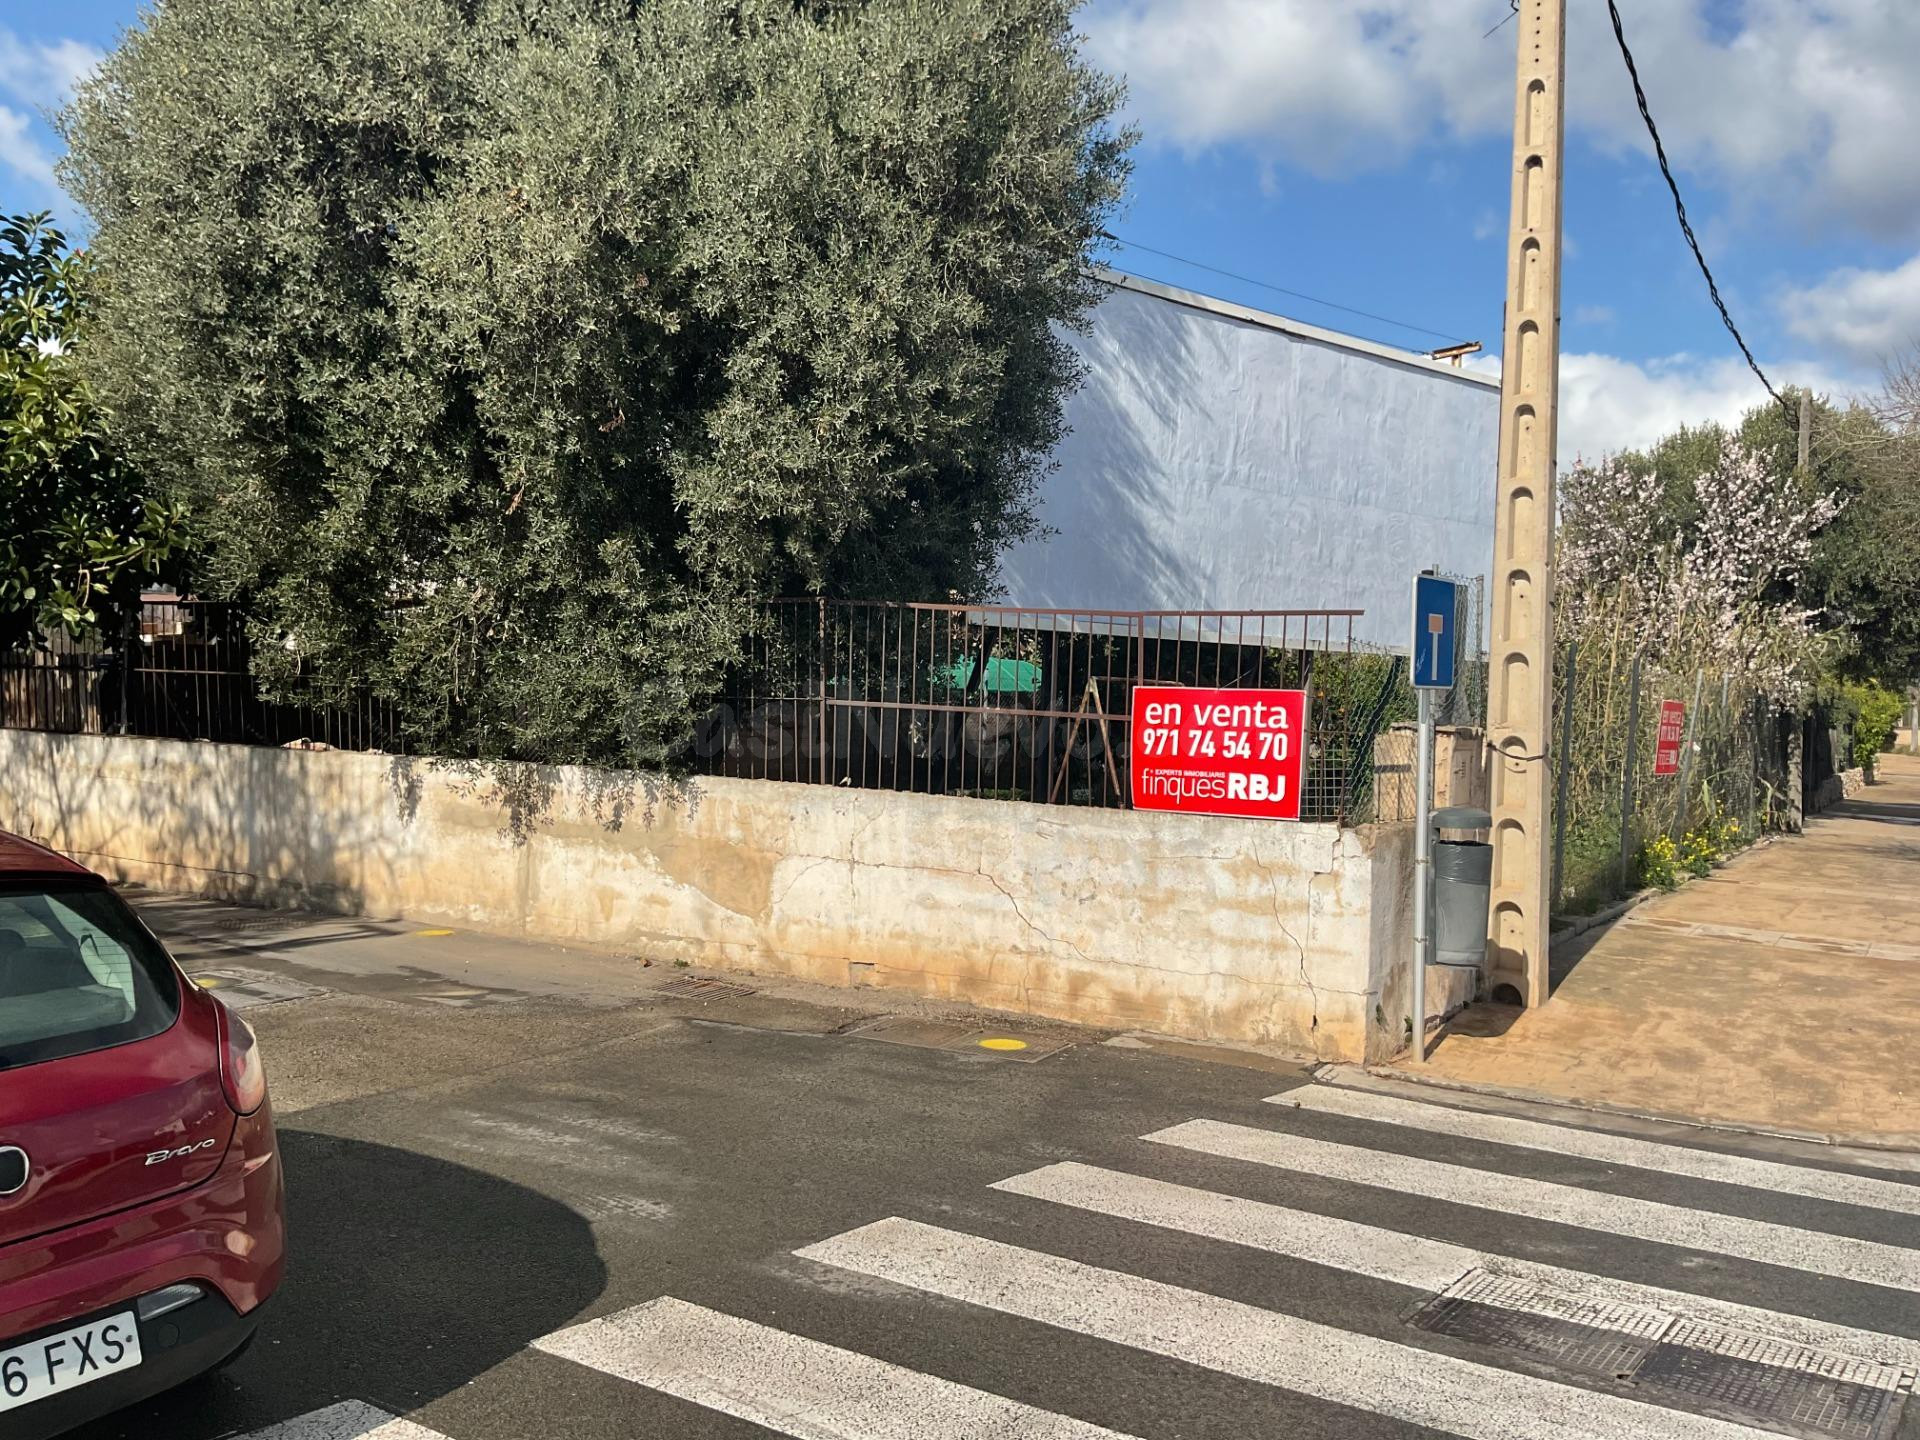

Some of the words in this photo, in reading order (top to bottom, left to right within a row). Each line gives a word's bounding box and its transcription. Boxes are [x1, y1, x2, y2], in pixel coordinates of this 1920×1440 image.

[1145, 702, 1182, 725] en
[1193, 701, 1289, 729] venta
[1143, 728, 1179, 756] 971
[1188, 730, 1216, 757] 74
[1222, 731, 1251, 759] 54
[1259, 732, 1288, 761] 70
[1142, 768, 1226, 805] finques
[1227, 772, 1286, 803] RBJ
[1155, 768, 1182, 776] EXPERTS
[1184, 770, 1226, 779] IMMOBILIARIS
[145, 1139, 215, 1166] Bravo
[2, 1356, 28, 1397] 6
[44, 1324, 124, 1385] FXS
